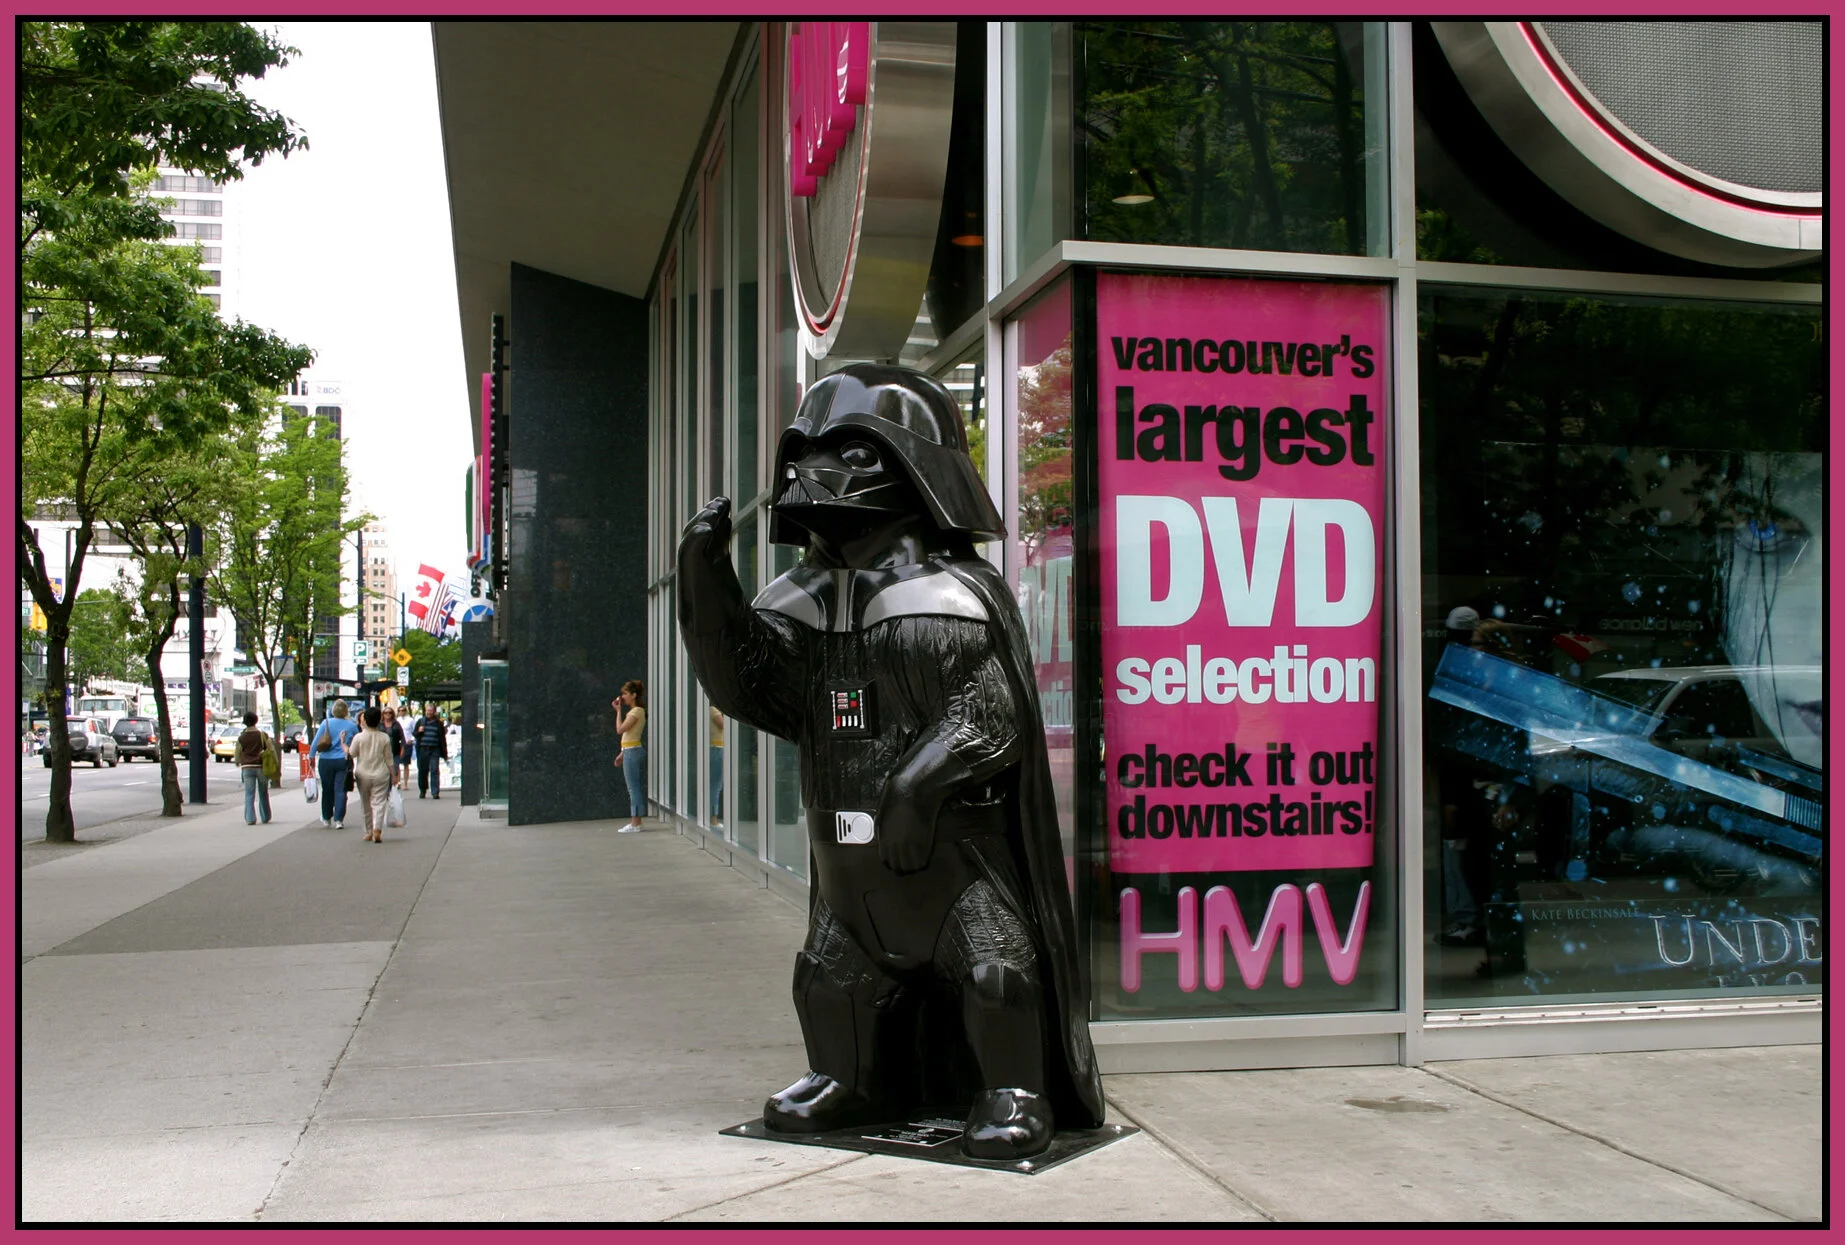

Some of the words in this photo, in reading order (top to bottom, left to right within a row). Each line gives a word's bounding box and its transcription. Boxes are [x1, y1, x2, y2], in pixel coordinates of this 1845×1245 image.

[1111, 334, 1375, 379] vancouver's
[1115, 386, 1375, 482] largest
[1116, 495, 1376, 628] DVD
[1116, 644, 1375, 705] selection
[1117, 743, 1253, 789] check
[1266, 742, 1296, 787] it
[1308, 741, 1374, 786] out
[1117, 791, 1374, 840] downstairs!
[1119, 879, 1372, 994] HMV
[1531, 908, 1562, 921] KATE
[1566, 906, 1640, 920] BECKINSALE
